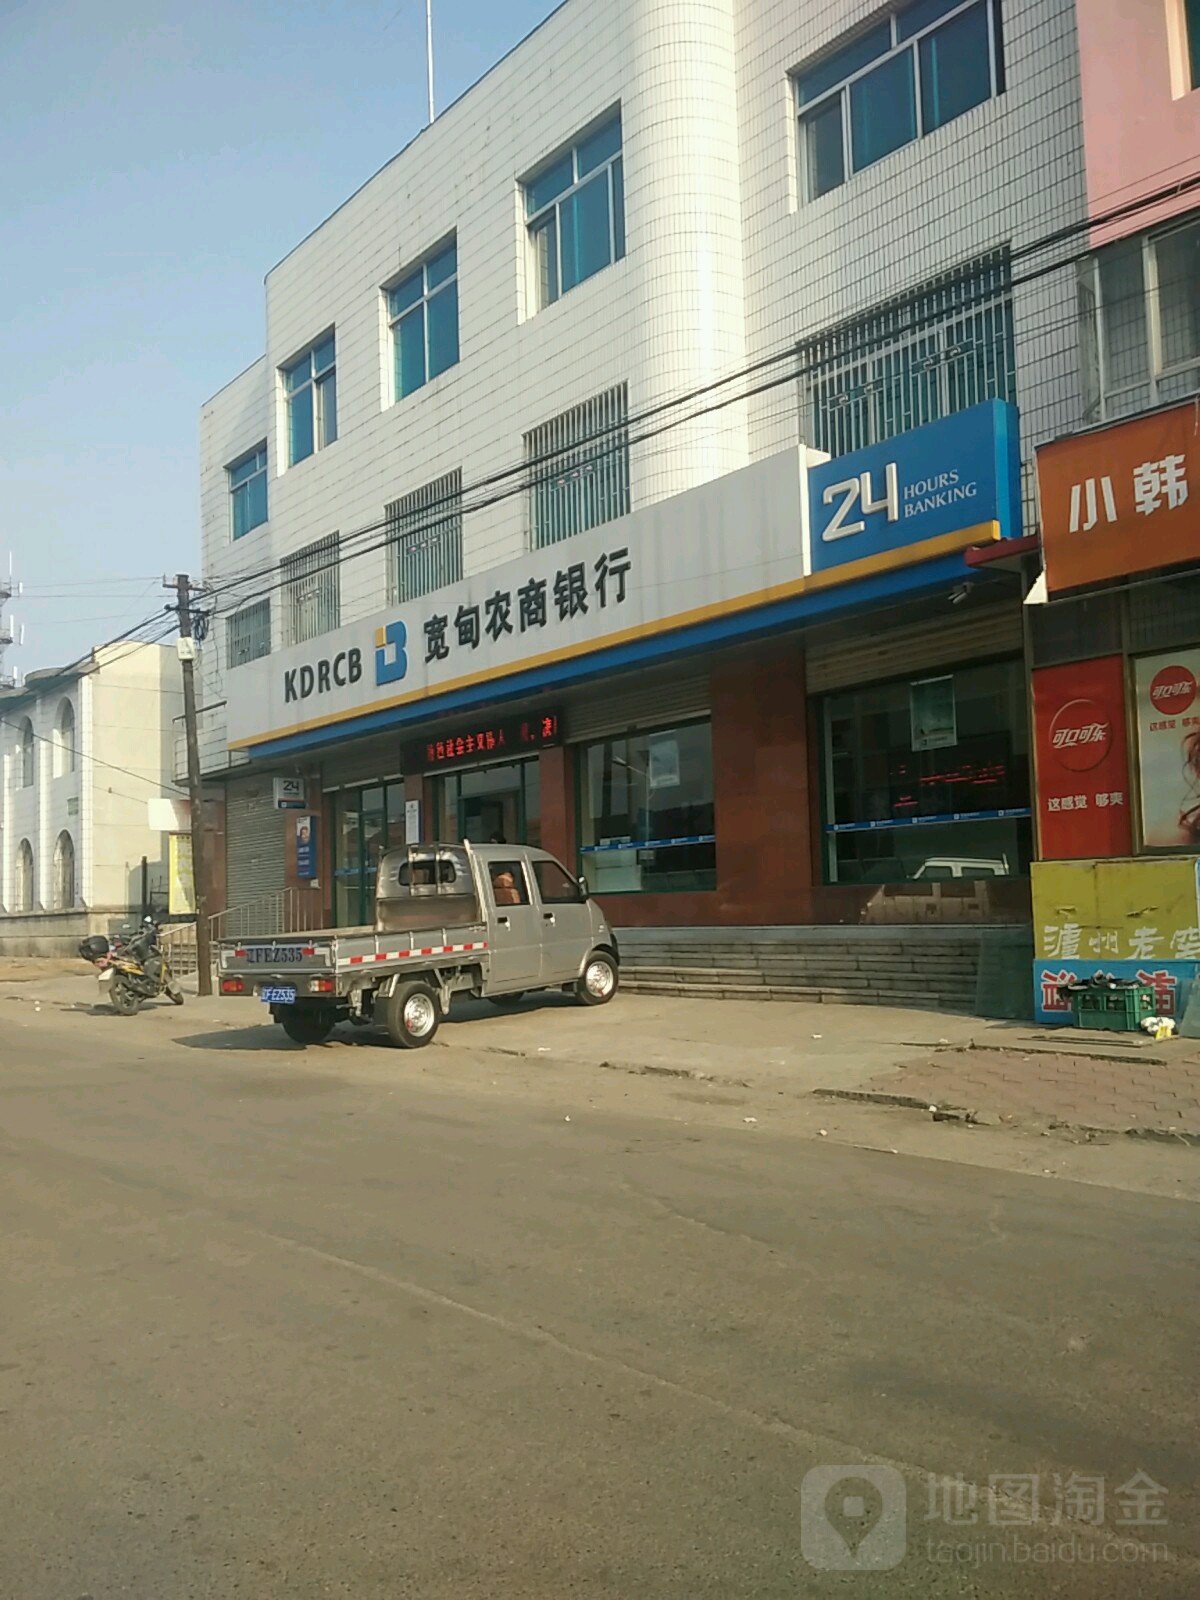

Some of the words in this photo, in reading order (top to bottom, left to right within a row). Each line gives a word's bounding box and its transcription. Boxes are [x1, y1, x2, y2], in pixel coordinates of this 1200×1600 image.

[822, 462, 898, 542] 24
[903, 468, 960, 500] HOURS
[903, 481, 978, 518] BANKING
[423, 547, 632, 664] 宽甸农商银行
[284, 647, 362, 702] KDRCB
[1052, 722, 1110, 749] 可口可乐
